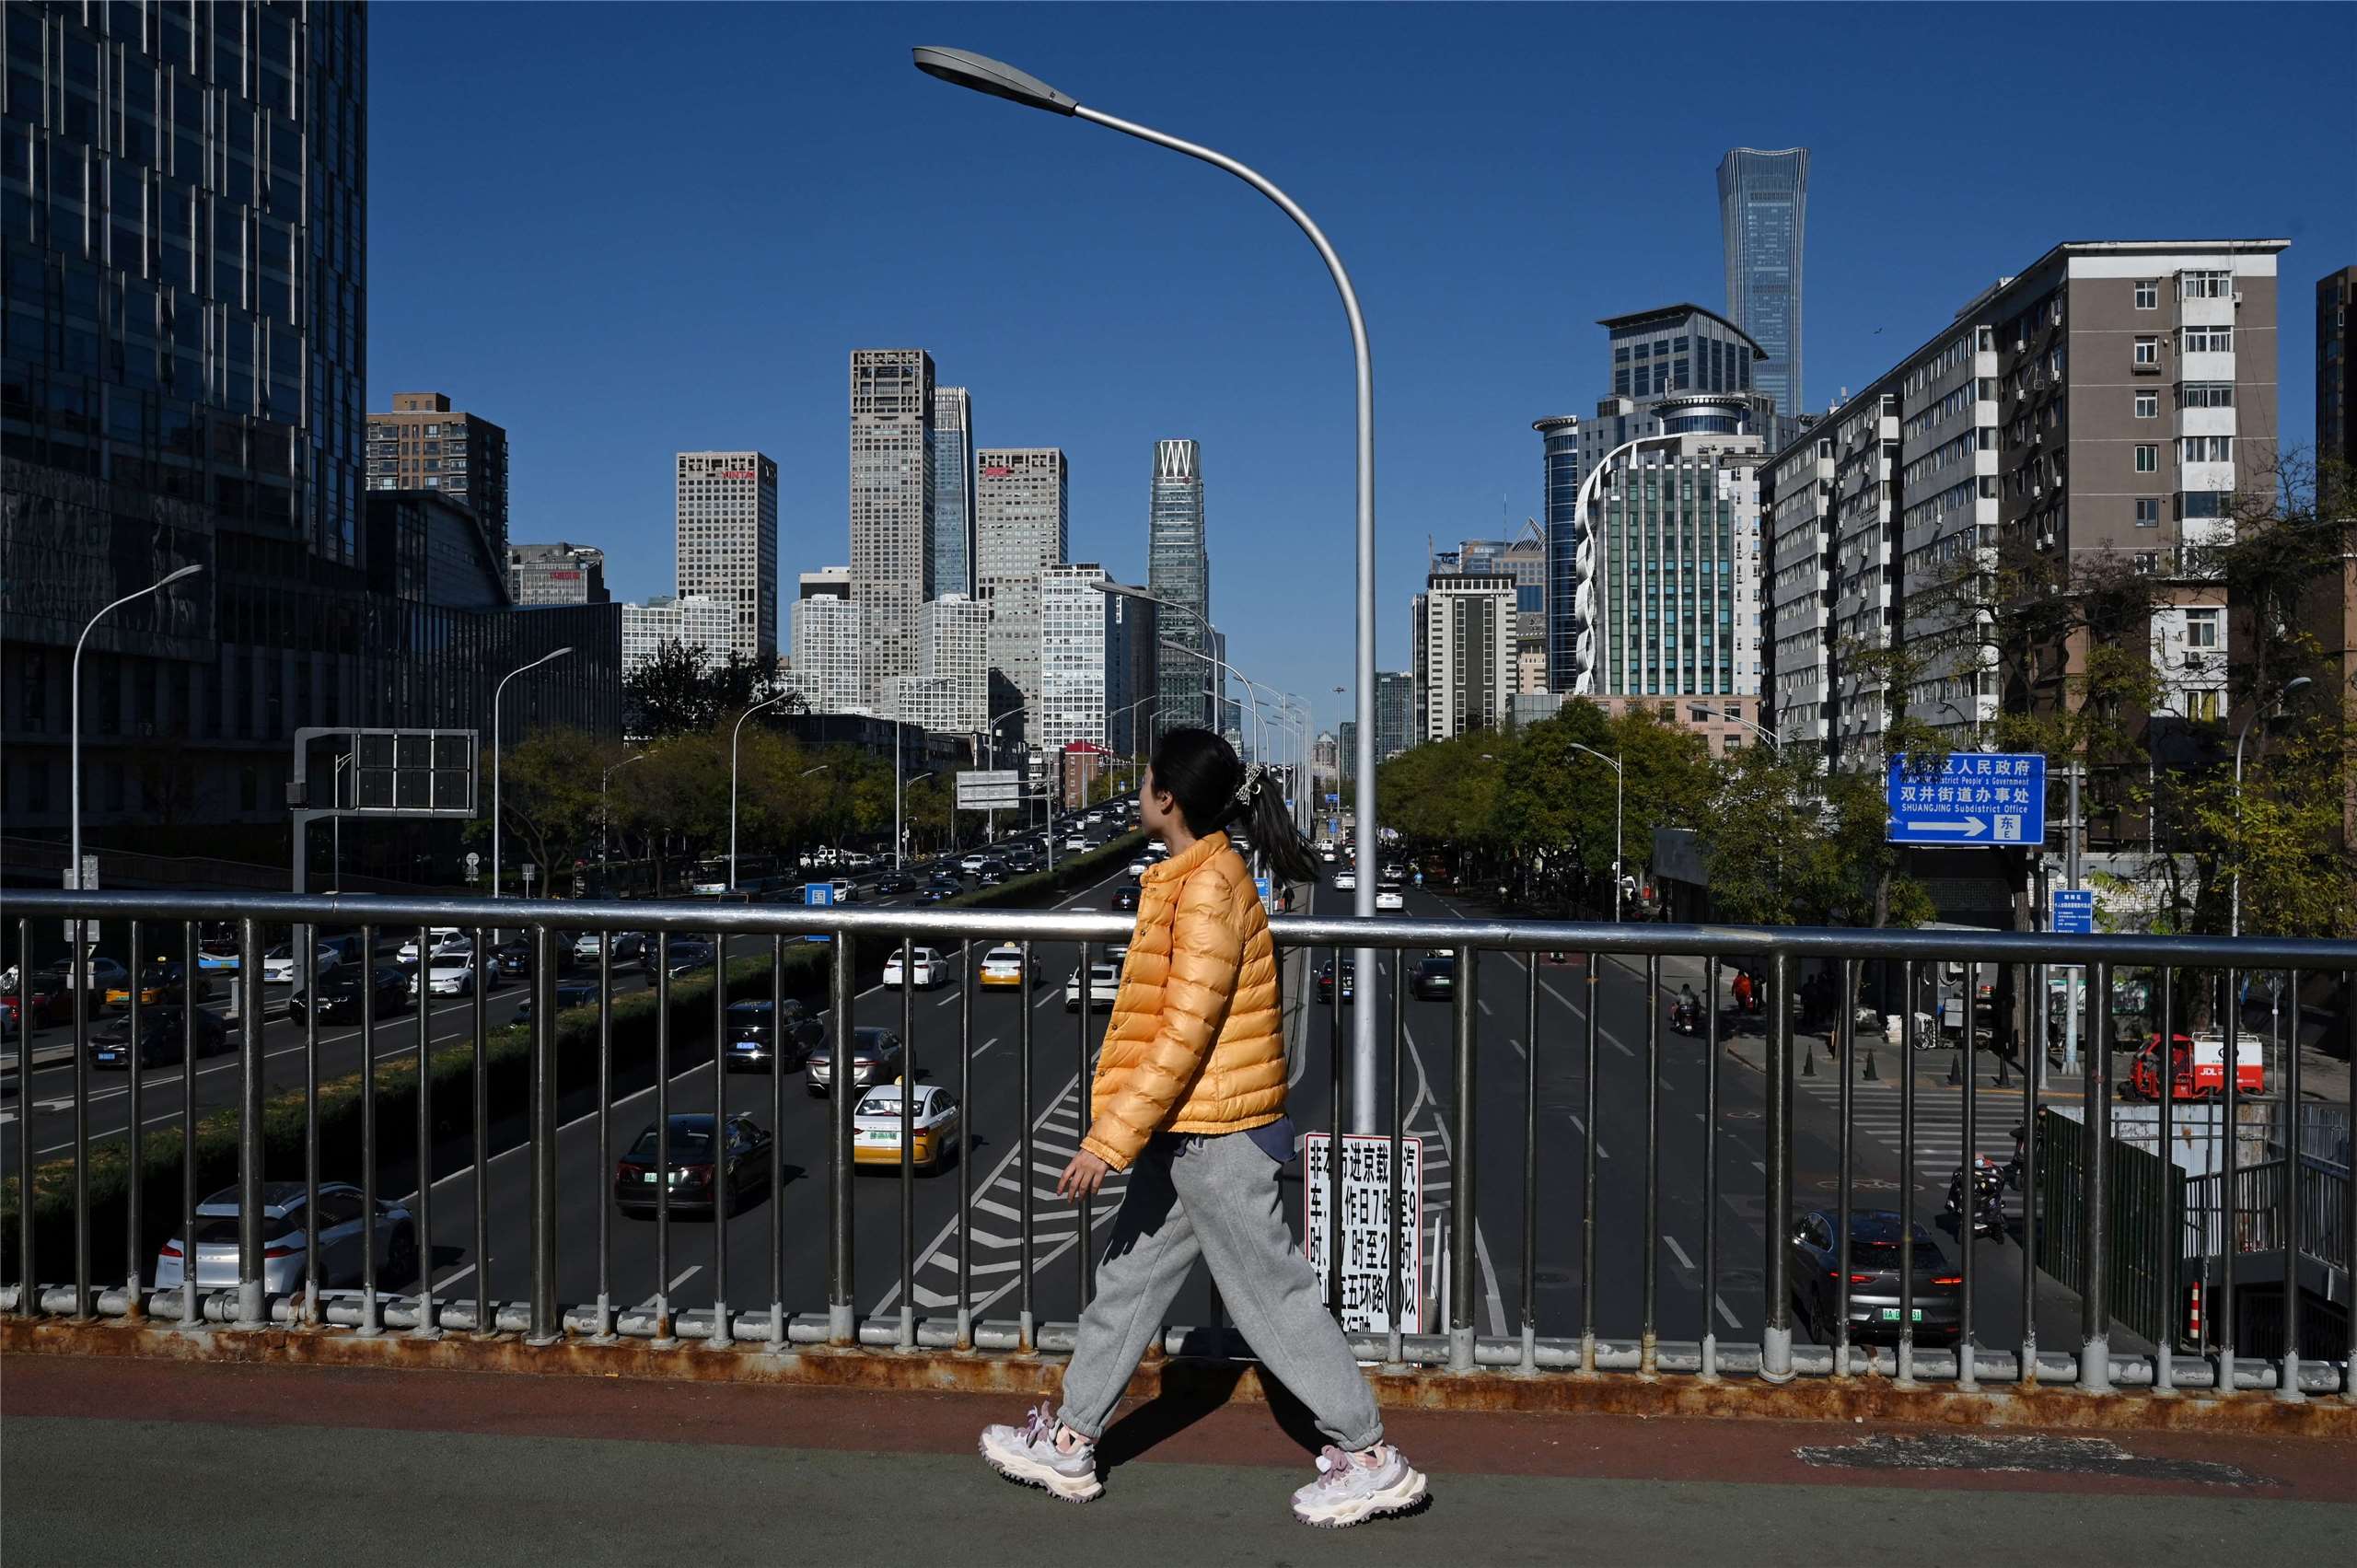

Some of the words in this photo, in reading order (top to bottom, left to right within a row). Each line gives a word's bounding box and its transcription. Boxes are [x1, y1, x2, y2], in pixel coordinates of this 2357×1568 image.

[1901, 759, 2030, 776] 区人民政府
[1991, 777, 2029, 785] Government
[1900, 786, 2029, 804] 双井街道办事处
[1901, 804, 1951, 813] SHUANGJING
[1955, 805, 2000, 814] Subdistrict
[2003, 805, 2028, 814] Office
[2001, 816, 2014, 830] 东
[2004, 830, 2010, 839] E
[2200, 1068, 2217, 1076] JDL
[1310, 1140, 1416, 1186] 非本市进京载汽
